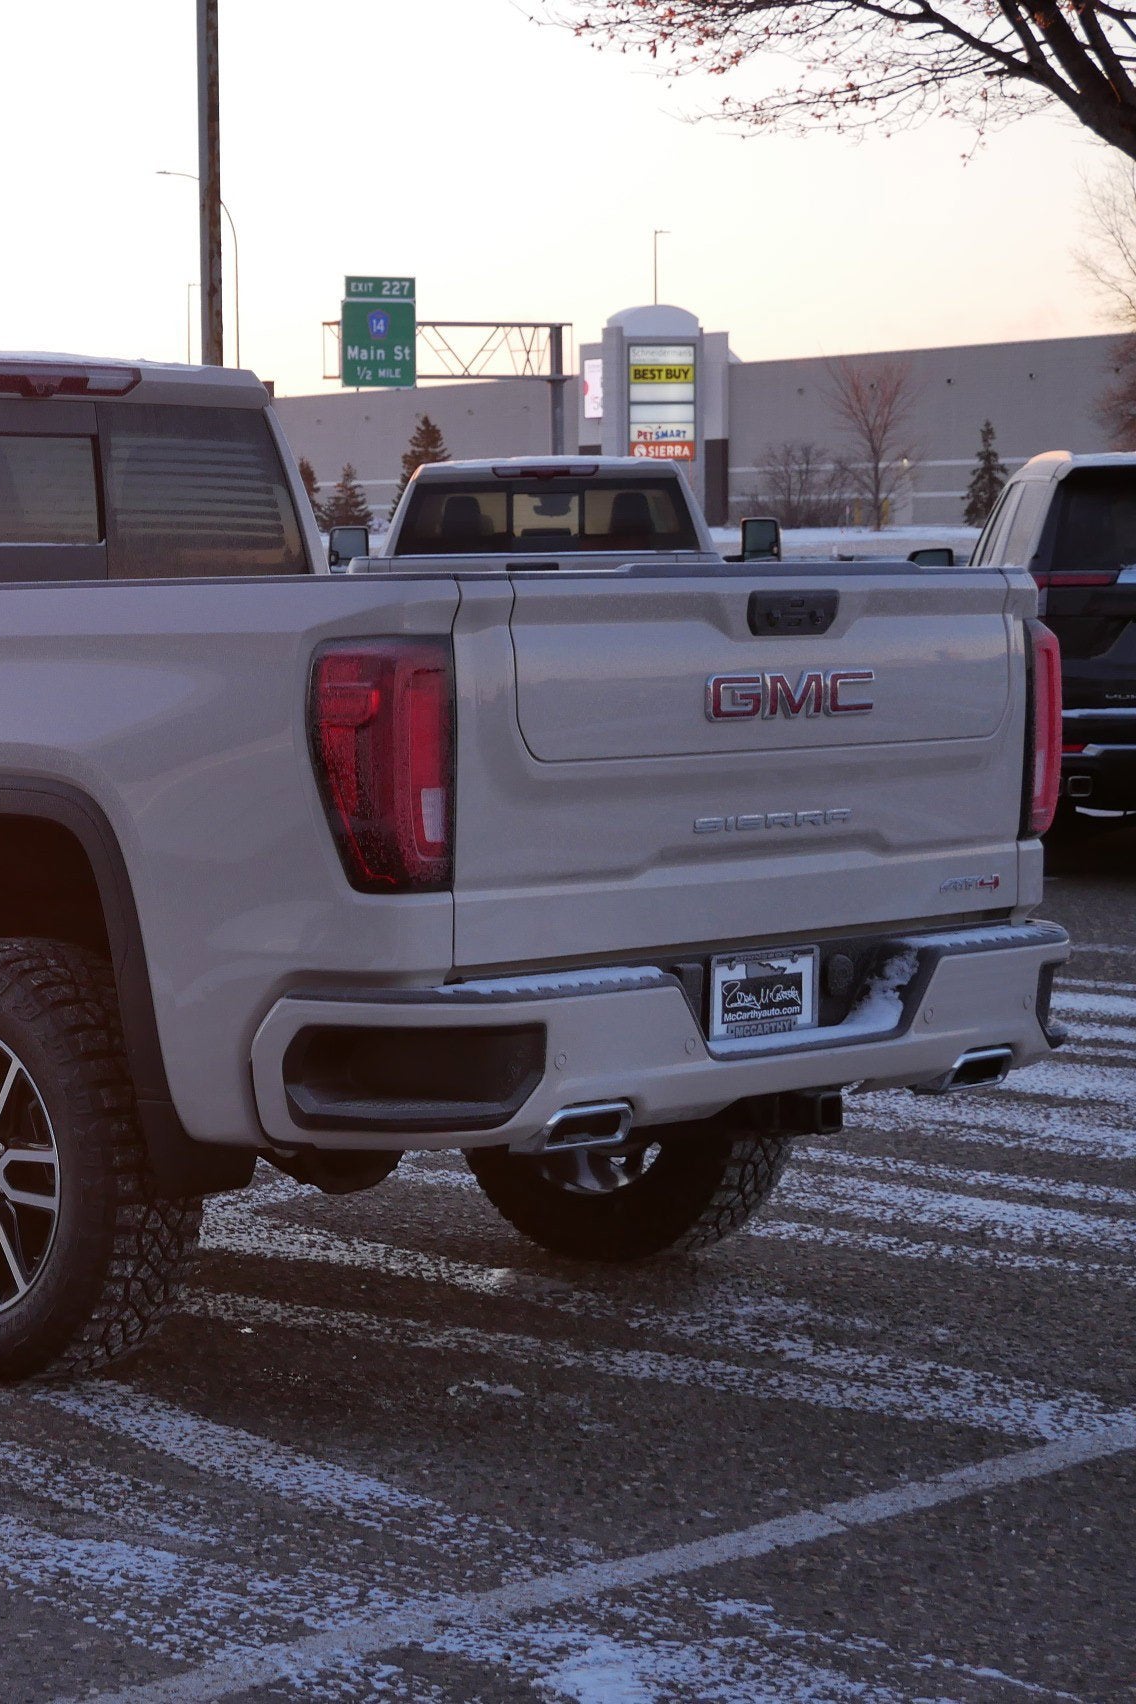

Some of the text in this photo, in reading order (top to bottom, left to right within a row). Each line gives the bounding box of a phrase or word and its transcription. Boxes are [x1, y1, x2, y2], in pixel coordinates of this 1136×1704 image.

[350, 281, 410, 295] EXIT 227
[372, 318, 385, 334] 14
[347, 345, 411, 361] Main St
[378, 368, 402, 379] MILE
[633, 368, 691, 380] BEST BUY
[648, 444, 691, 457] SIERRA
[705, 669, 874, 722] GMC
[693, 808, 852, 834] SIERRA
[723, 1006, 800, 1022] McCarthyauto.com
[735, 1020, 792, 1038] MCCARTHY
